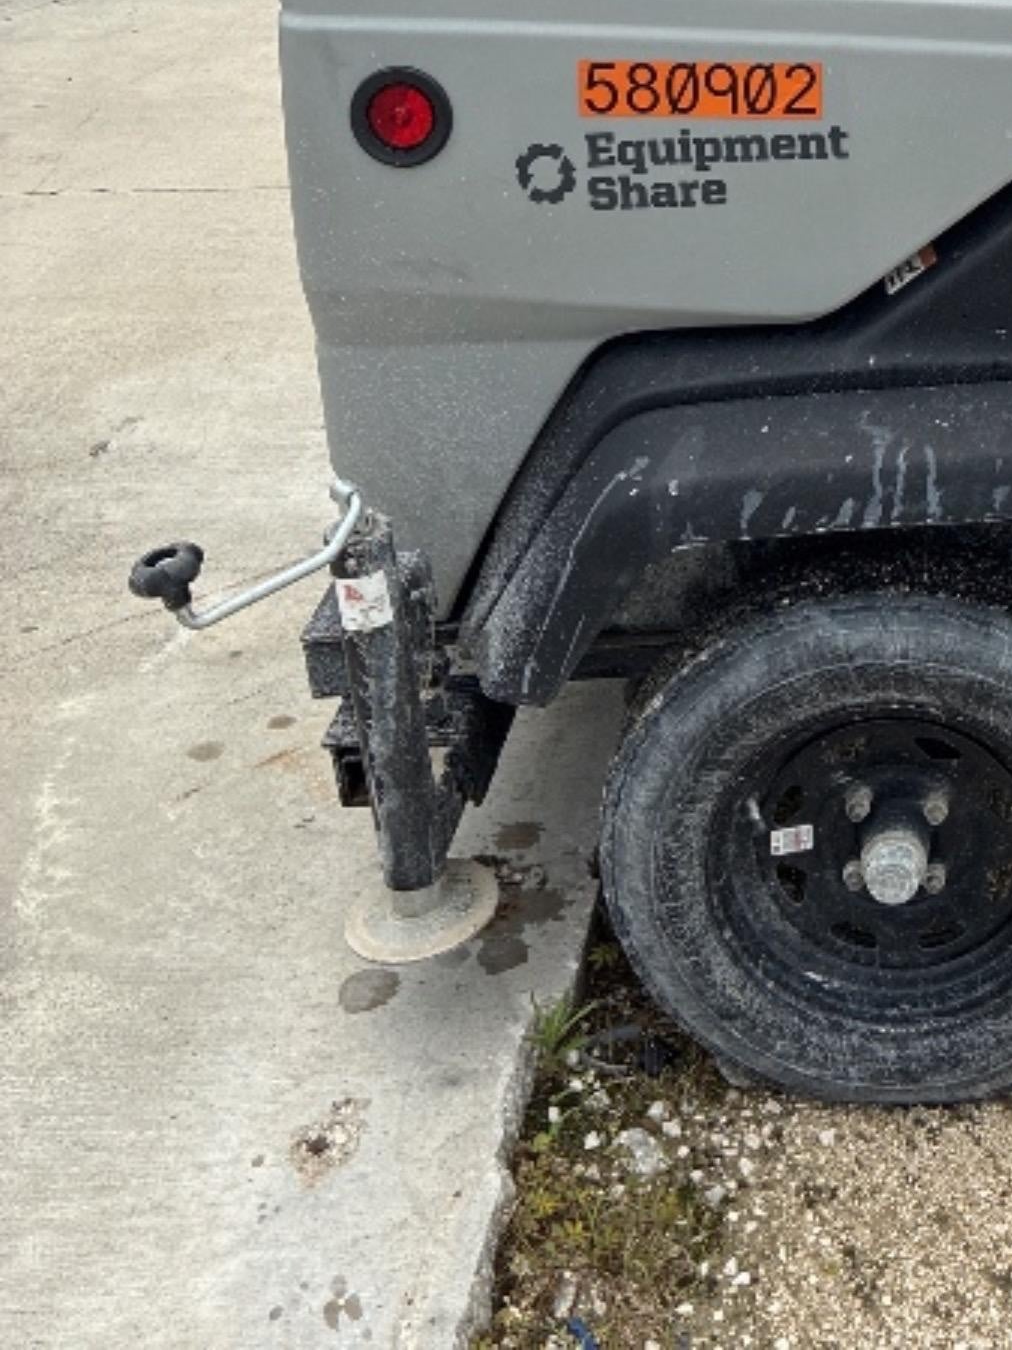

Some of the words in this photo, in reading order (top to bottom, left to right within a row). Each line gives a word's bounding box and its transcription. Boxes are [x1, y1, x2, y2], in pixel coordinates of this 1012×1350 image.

[584, 62, 818, 116] 580902
[585, 125, 849, 175] Equipment
[587, 175, 728, 211] Share
